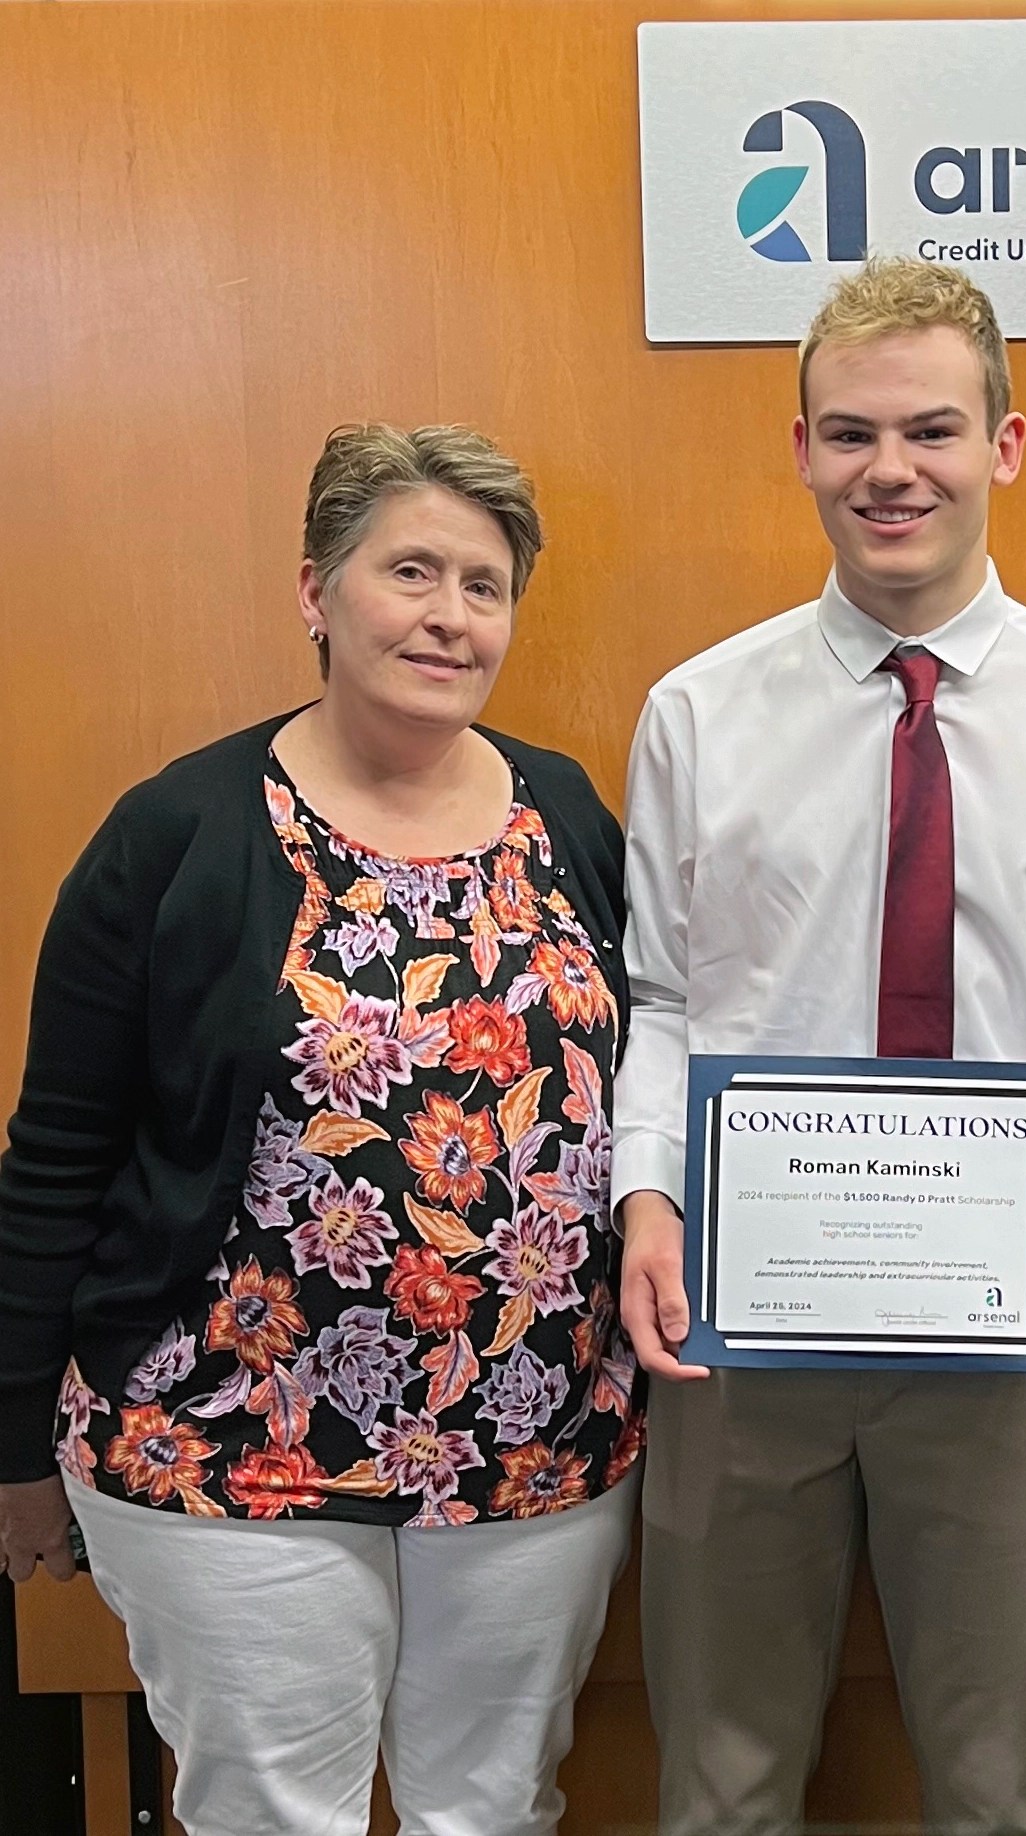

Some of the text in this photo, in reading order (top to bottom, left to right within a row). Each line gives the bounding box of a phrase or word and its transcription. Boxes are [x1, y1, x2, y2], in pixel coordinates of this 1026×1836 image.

[918, 238, 1000, 261] Credit
[789, 1158, 961, 1178] Roman Kaminski
[737, 1190, 763, 1200] 2024
[765, 1191, 809, 1202] recipient
[812, 1191, 822, 1200] of
[824, 1191, 840, 1201] the
[882, 1193, 916, 1204] Randy
[918, 1194, 925, 1203] D
[927, 1194, 955, 1204] Pratt
[957, 1195, 1016, 1206] Scholarship
[819, 1220, 923, 1231] Recognizing outstanding
[822, 1230, 842, 1239] high
[844, 1230, 870, 1239] school
[872, 1231, 903, 1239] seniors
[767, 1257, 811, 1266] Academic
[879, 1260, 931, 1269] community
[754, 1270, 819, 1278] demonstrated
[819, 1271, 867, 1280] leadership
[868, 1271, 886, 1279] and
[886, 1272, 956, 1281] extracurricular
[750, 1301, 771, 1311] April
[788, 1302, 812, 1311] 2024
[967, 1310, 1020, 1323] arsenal
